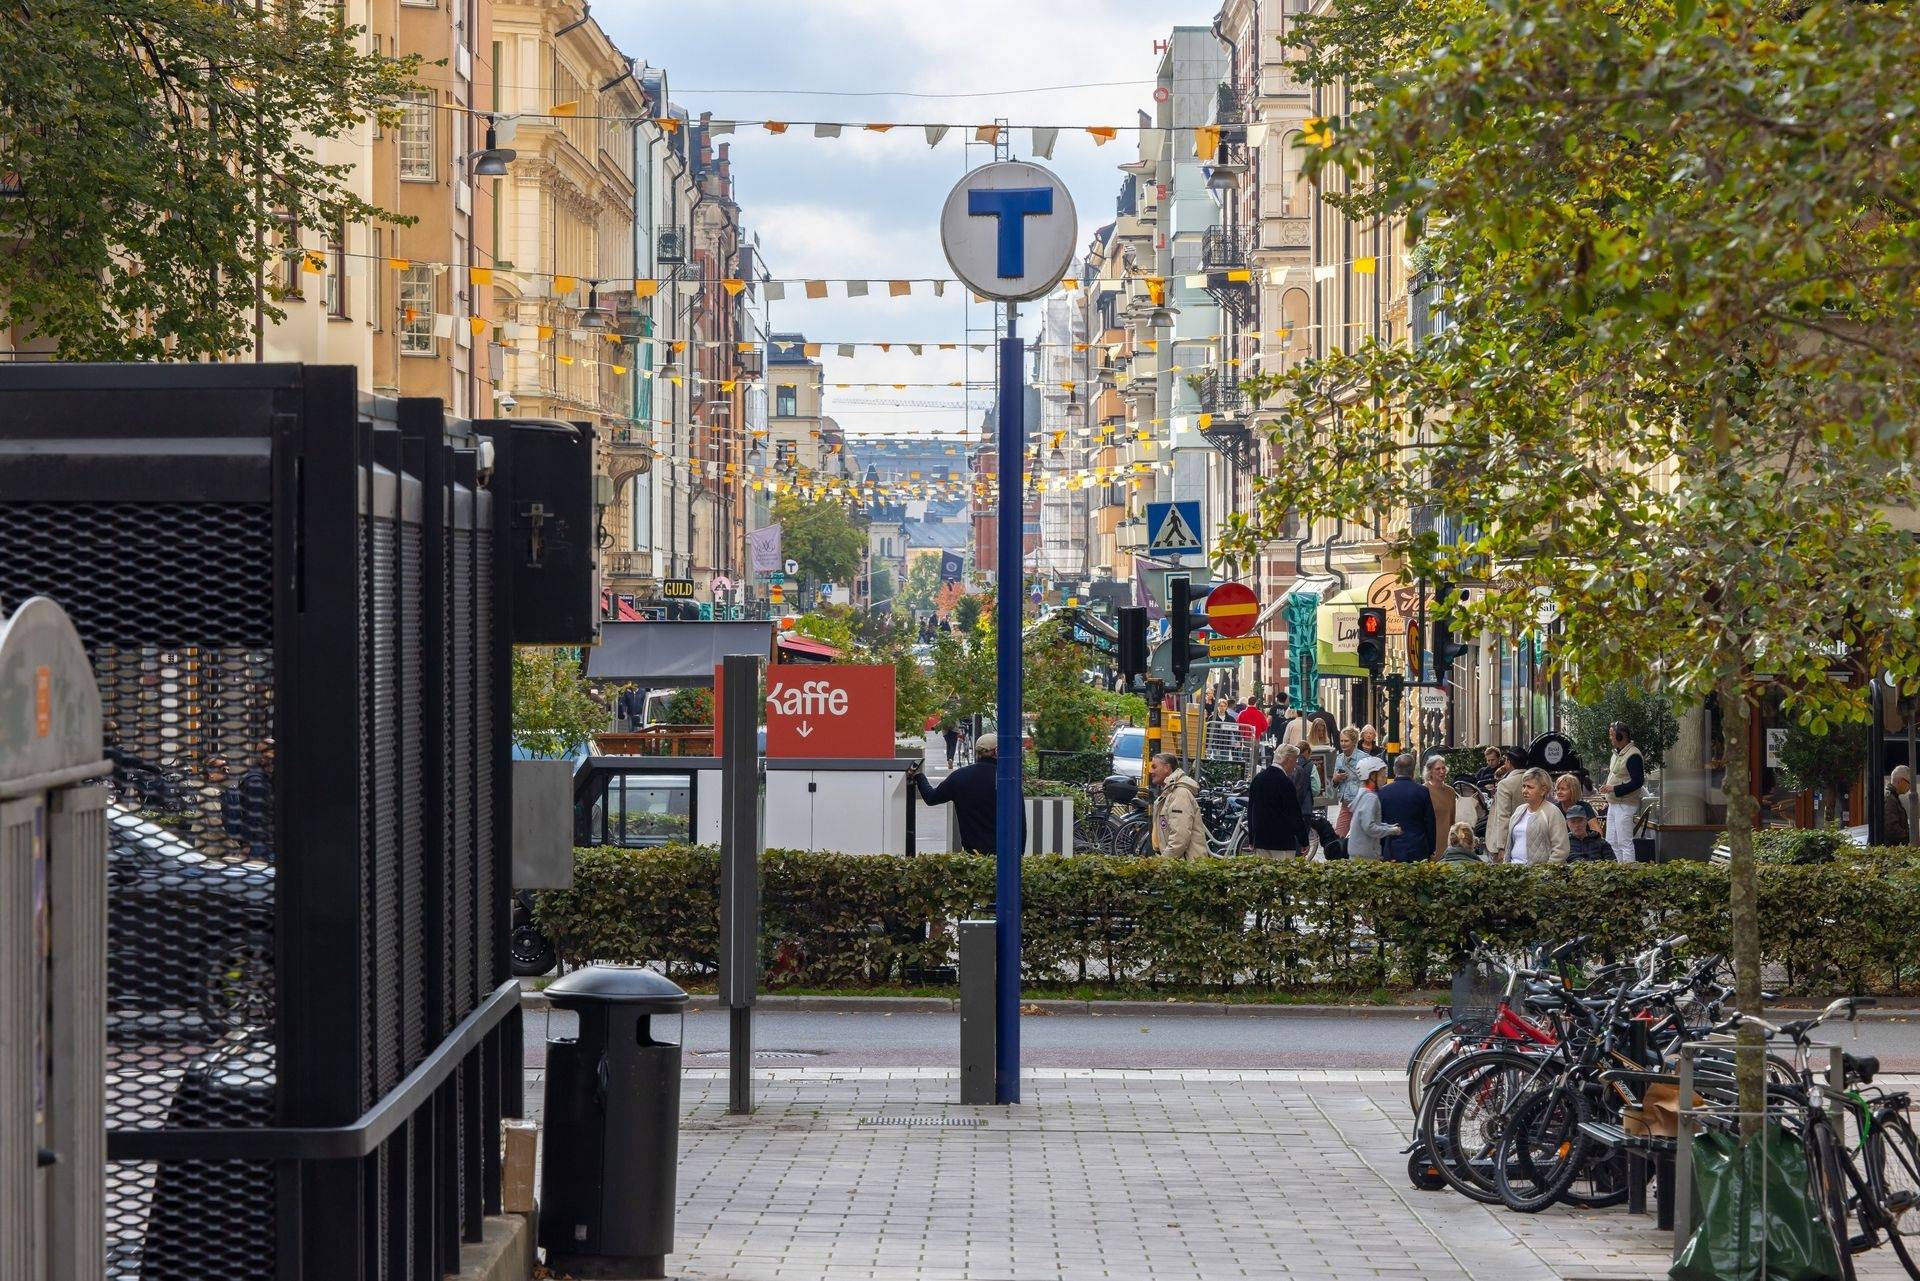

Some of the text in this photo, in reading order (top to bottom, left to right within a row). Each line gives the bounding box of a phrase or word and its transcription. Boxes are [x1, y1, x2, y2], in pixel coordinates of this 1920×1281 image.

[967, 186, 1054, 279] T
[787, 563, 796, 573] T
[664, 582, 693, 596] GULD
[766, 680, 849, 716] Kaffe
